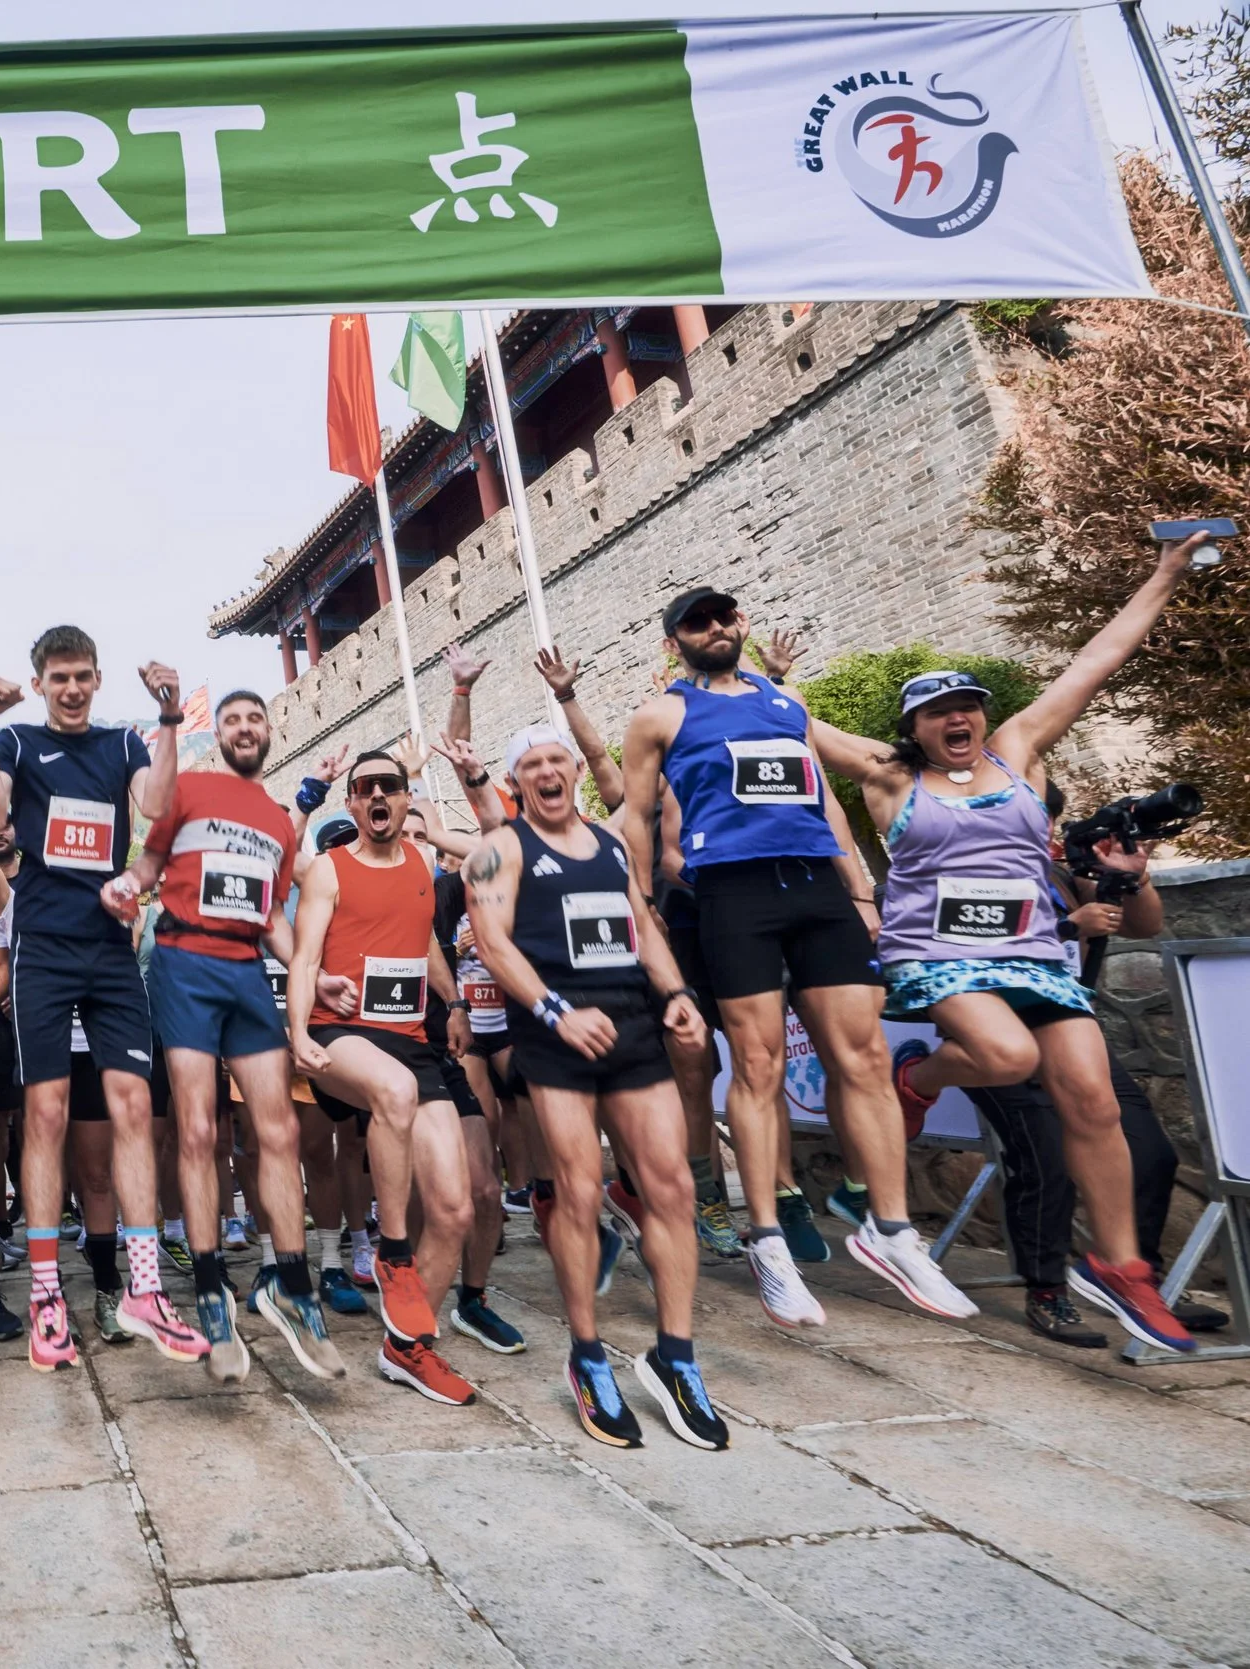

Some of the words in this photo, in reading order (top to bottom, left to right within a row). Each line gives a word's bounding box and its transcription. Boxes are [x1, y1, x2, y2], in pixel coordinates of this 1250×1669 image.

[803, 93, 836, 173] GREAT
[832, 70, 914, 96] WALL
[410, 91, 559, 233] 点
[937, 179, 995, 232] MARATHON
[758, 761, 785, 781] 83
[745, 784, 798, 793] MARATHON
[64, 824, 96, 848] 518
[211, 895, 256, 912] MARATHON
[958, 904, 1006, 924] 335
[949, 924, 1009, 935] MARATHON
[390, 983, 403, 1000] 4
[474, 987, 495, 1000] 871
[373, 1003, 414, 1011] MARATHON
